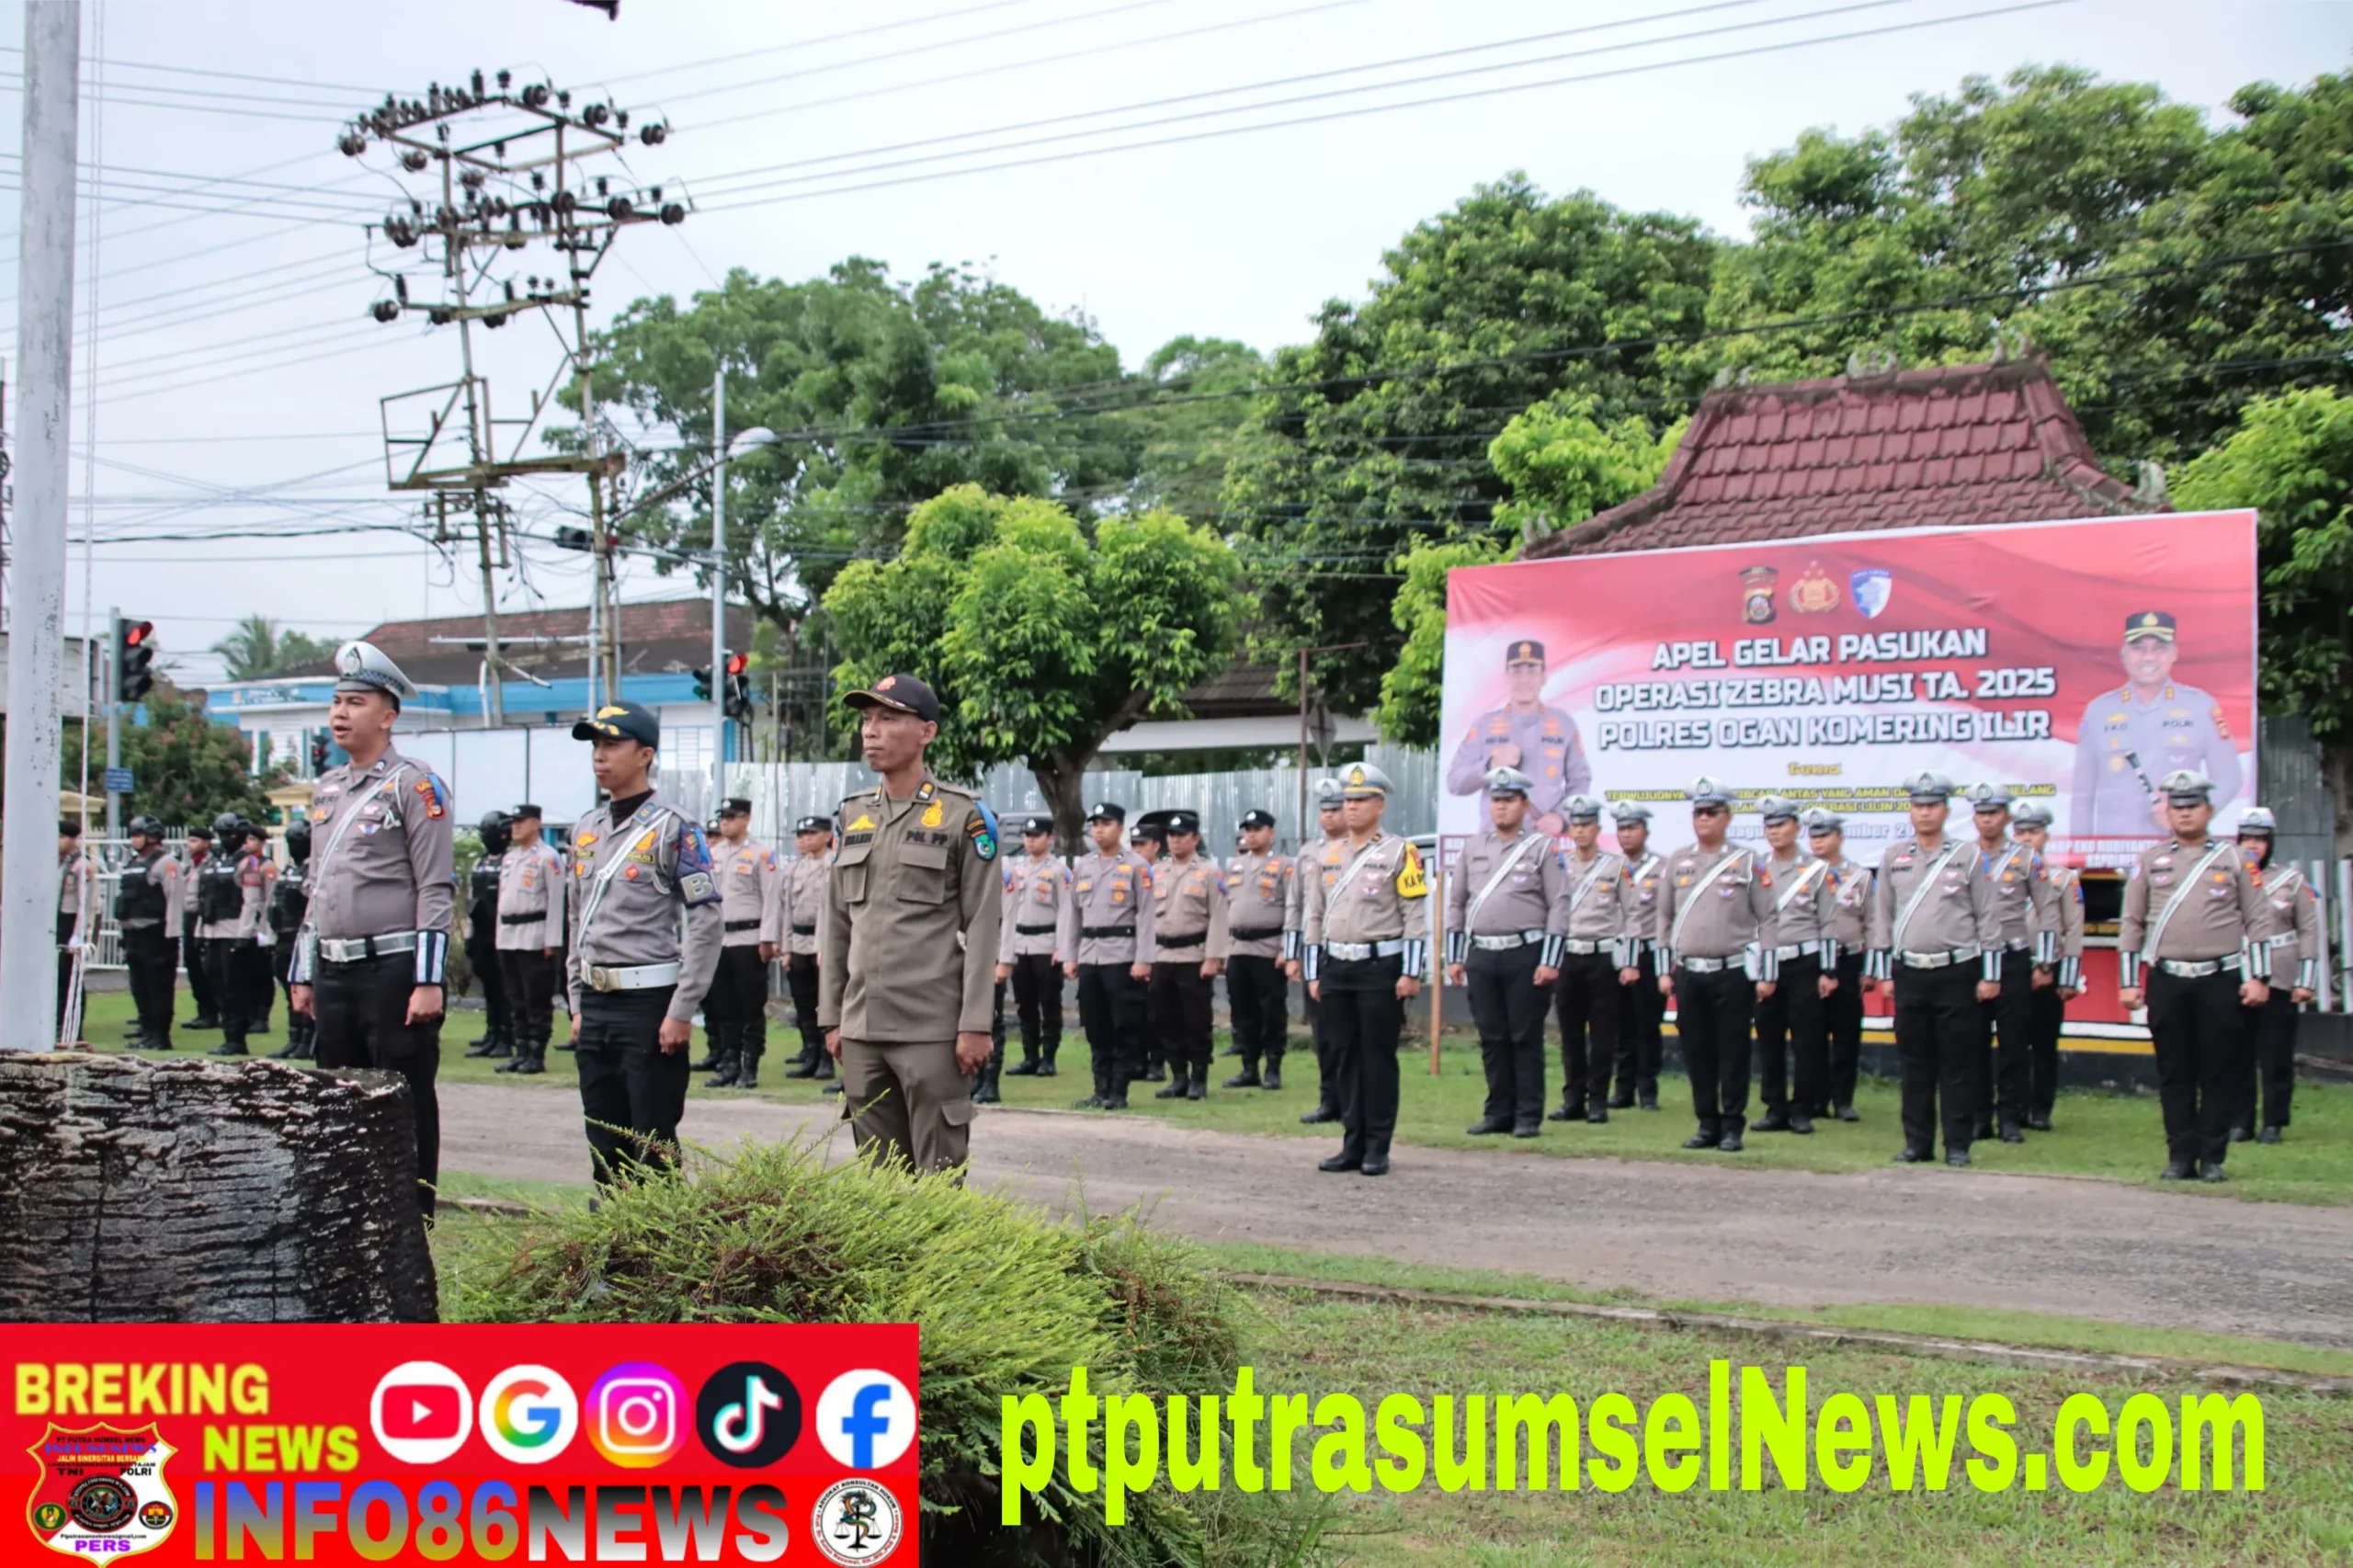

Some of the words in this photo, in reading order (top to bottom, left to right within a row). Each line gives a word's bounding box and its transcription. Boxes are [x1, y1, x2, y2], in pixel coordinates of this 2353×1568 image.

[1652, 642, 1726, 670] APEL
[1733, 636, 1830, 666] GELAR
[1839, 629, 1987, 663] PASUKAN
[1595, 680, 1721, 711] OPERASI
[1726, 676, 1825, 708] ZEBRA
[1834, 672, 1915, 704] MUSI
[1921, 670, 1970, 701] TA.
[1976, 667, 2056, 699] 2025
[1598, 720, 1711, 751] POLRES
[1719, 717, 1802, 747] OGAN
[1807, 712, 1973, 745] KOMERING
[1980, 710, 2052, 741] ILIR
[1821, 788, 1854, 799] YANG
[1855, 787, 1891, 799] AMAN
